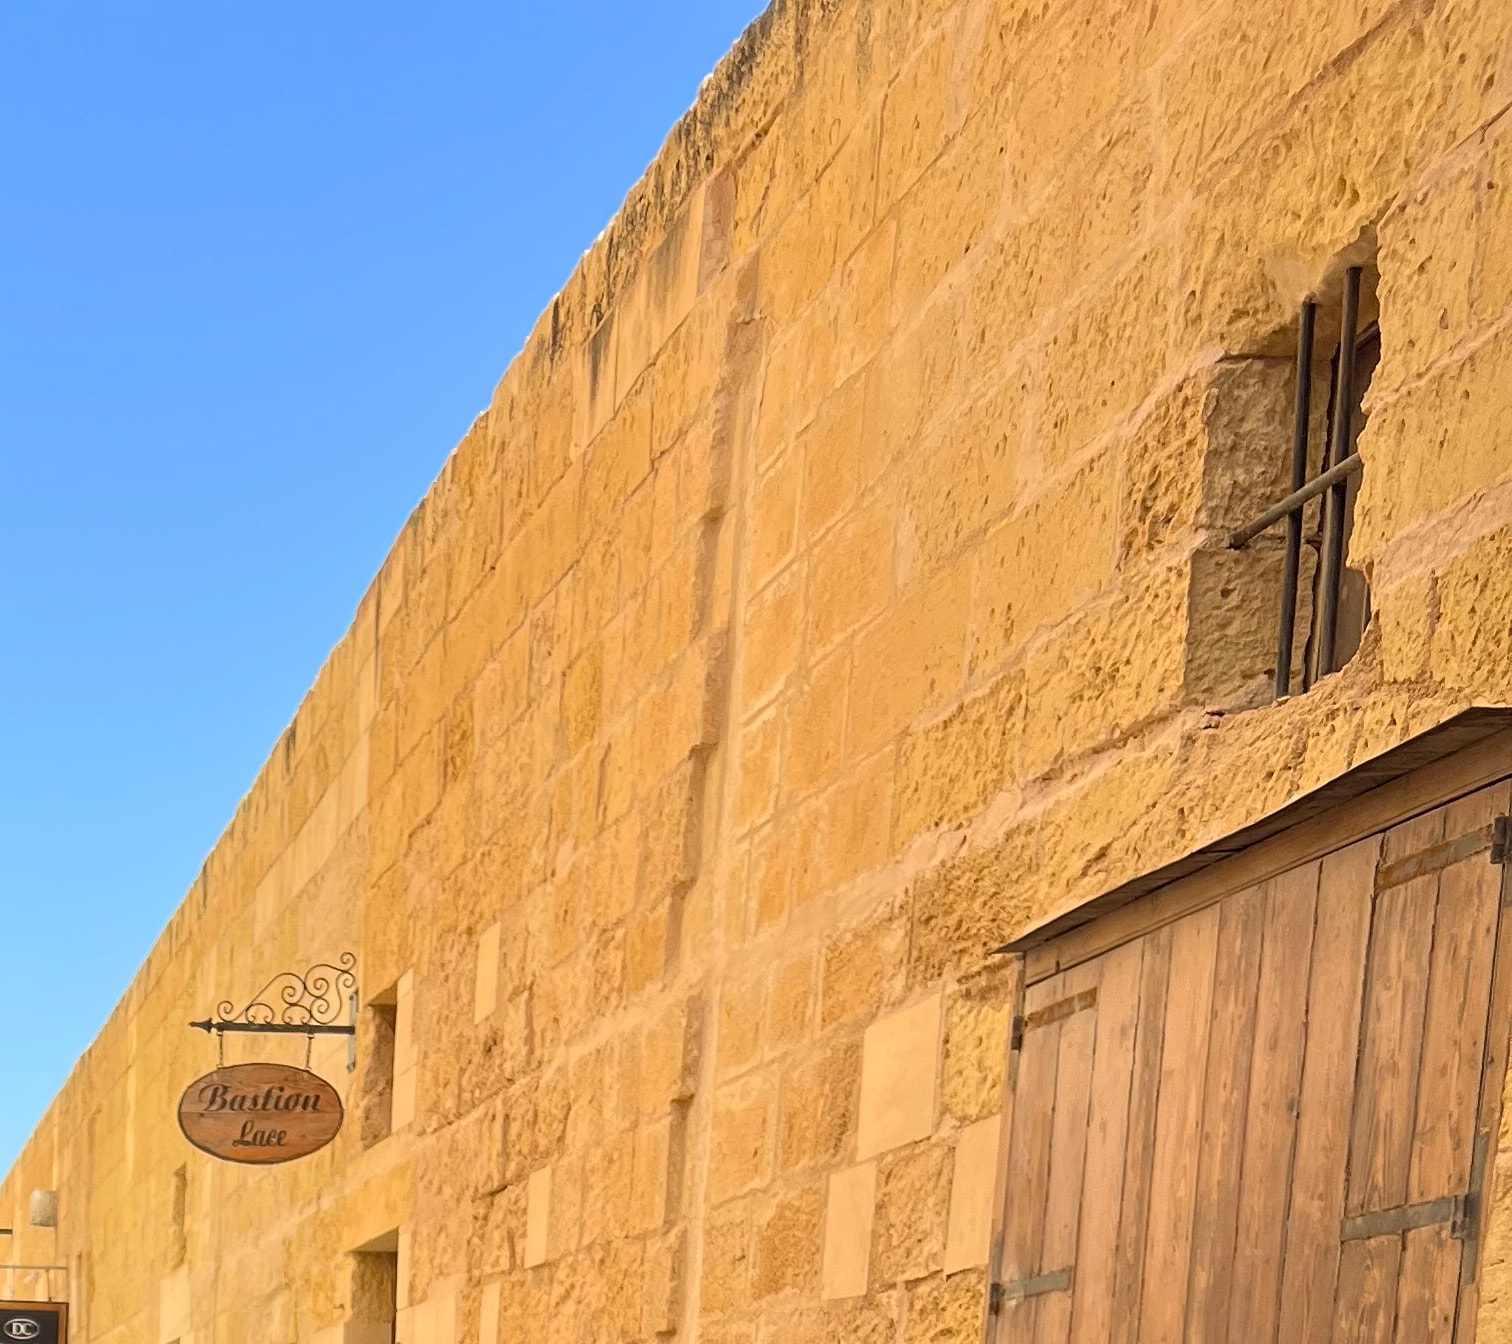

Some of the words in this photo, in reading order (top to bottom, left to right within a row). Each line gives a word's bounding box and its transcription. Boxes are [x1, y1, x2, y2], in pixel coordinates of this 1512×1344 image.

[197, 1083, 321, 1112] Bastion
[231, 1120, 288, 1147] Lace
[12, 1322, 33, 1336] DC
